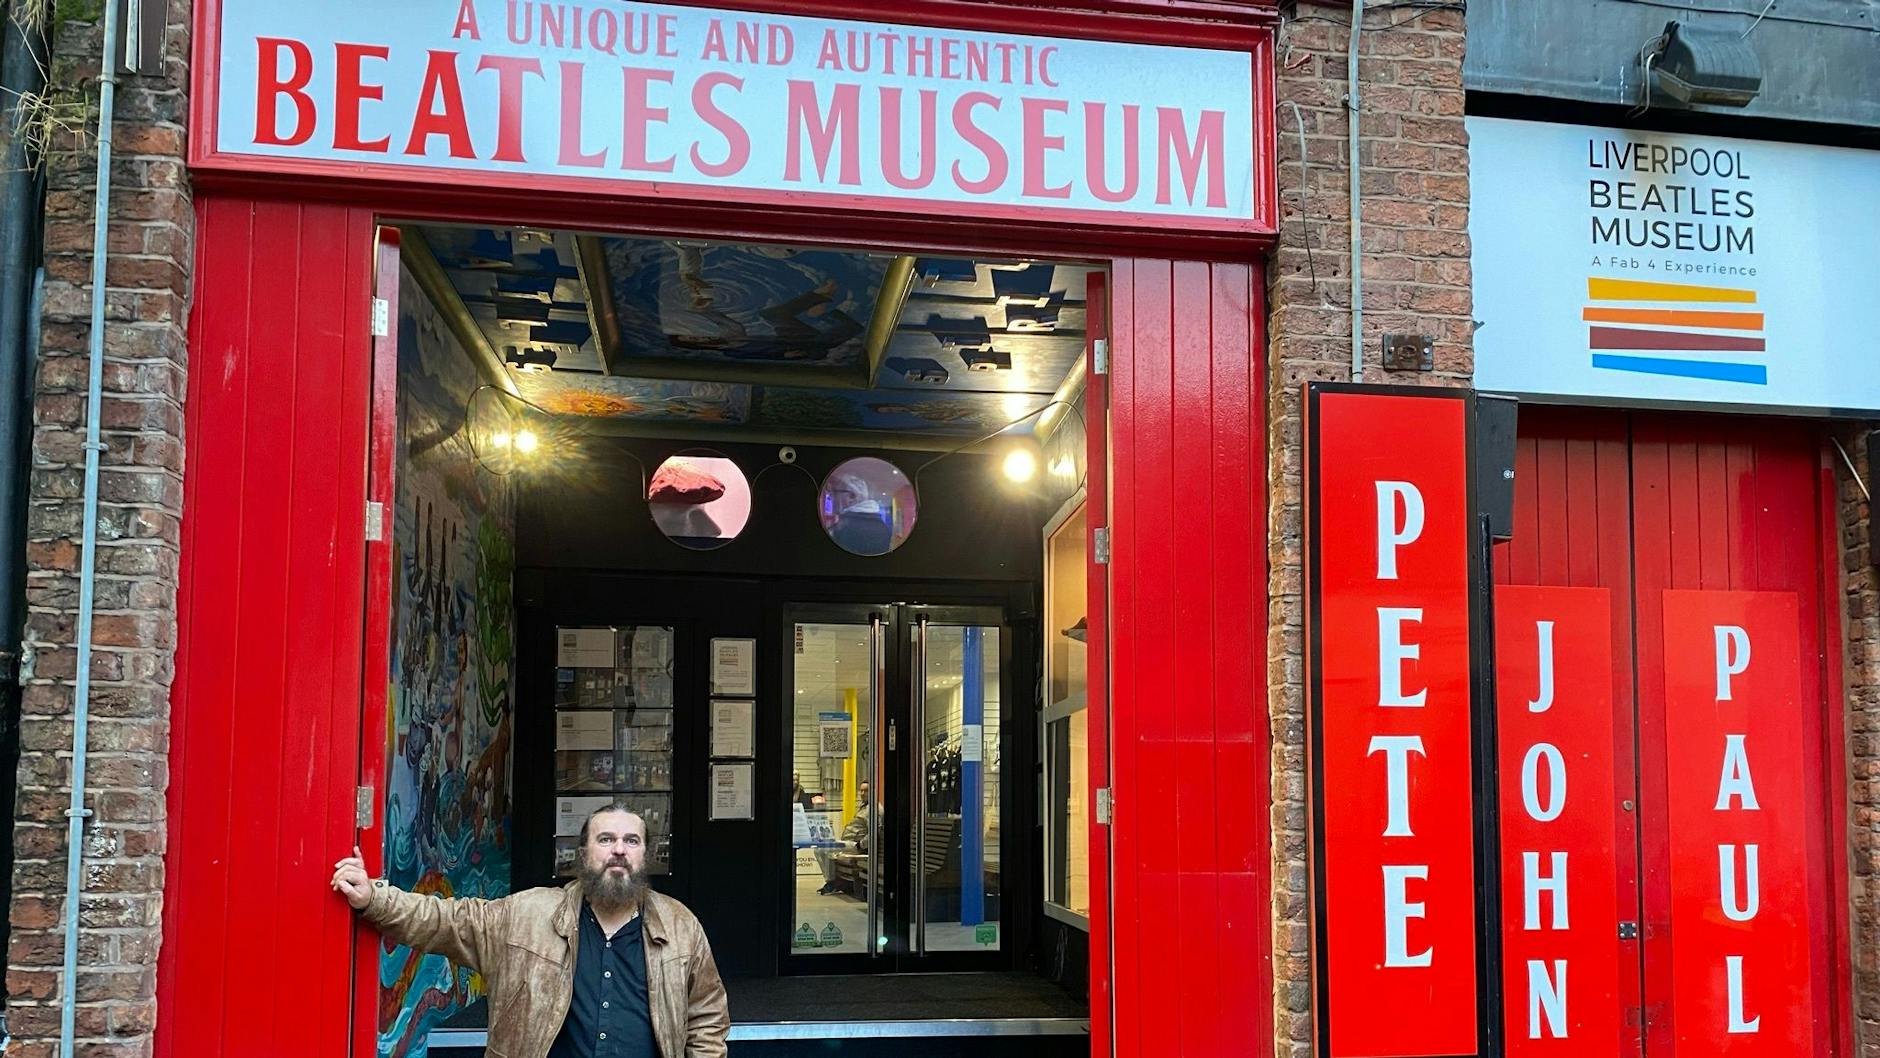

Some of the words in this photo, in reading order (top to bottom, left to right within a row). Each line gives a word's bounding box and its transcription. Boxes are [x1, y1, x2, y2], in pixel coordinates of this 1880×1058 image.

[452, 0, 482, 41] A
[506, 1, 679, 57] UNIQUE
[701, 20, 794, 66] AND
[816, 29, 1060, 87] AUTHENTIC
[252, 36, 751, 178] BEATLES
[783, 79, 1228, 209] MUSEUM
[1589, 139, 1751, 180] LIVERPOOL
[1589, 179, 1755, 219] BEATLES
[1592, 216, 1754, 255] MUSEUM
[1591, 256, 1602, 267] A
[1610, 257, 1640, 270] Fab
[1648, 259, 1656, 270] 4
[1665, 260, 1758, 277] Experience
[1366, 480, 1435, 968] PETE
[1520, 620, 1571, 1040] JOHN
[1713, 625, 1761, 1034] PAUL
